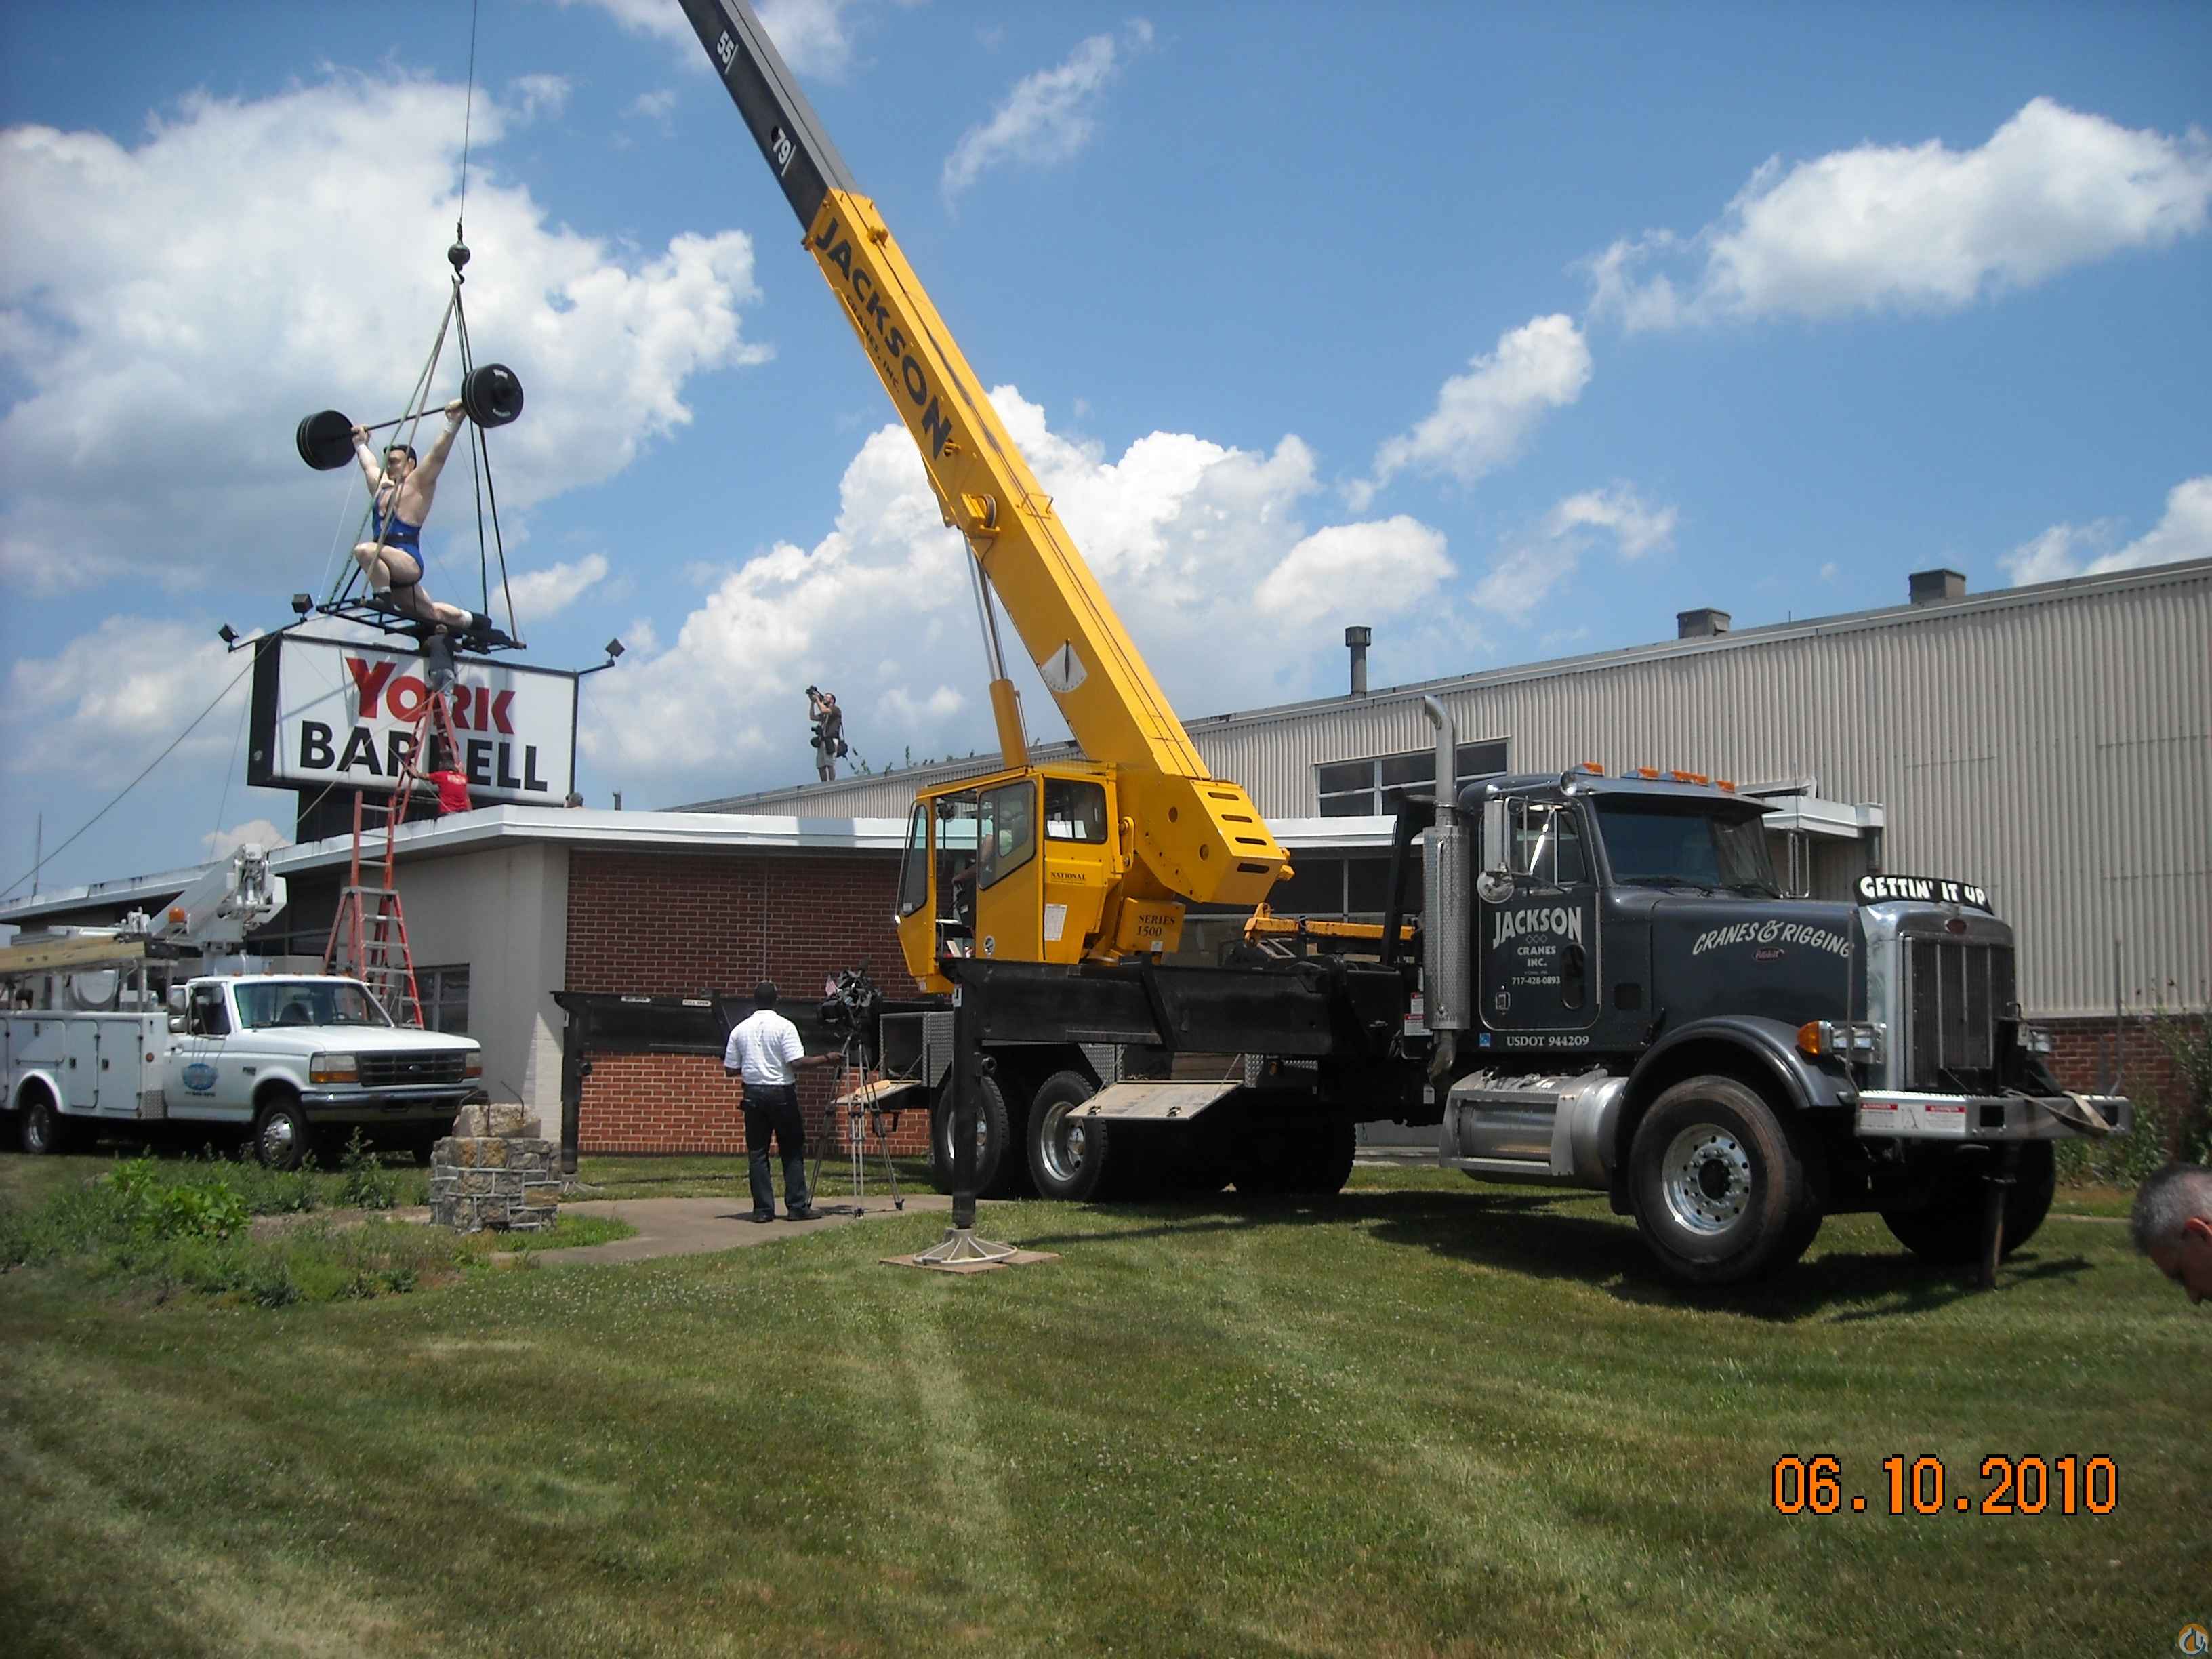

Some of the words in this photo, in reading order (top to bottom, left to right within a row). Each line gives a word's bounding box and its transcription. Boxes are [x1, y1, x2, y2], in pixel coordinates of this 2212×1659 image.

[717, 30, 734, 64] 55
[773, 127, 791, 165] 79
[815, 217, 953, 462] JACKSON
[345, 657, 516, 735] YORK
[1051, 872, 1085, 880] NATIONAL
[1860, 876, 1933, 899] GETTIN'
[1941, 882, 1959, 902] IT
[1964, 885, 1986, 906] UP
[1137, 926, 1162, 937] 1500
[1139, 915, 1175, 925] SERIES
[1493, 907, 1582, 949] JACKSON
[1517, 946, 1557, 956] CRANES
[1692, 922, 1759, 956] CRANES
[1757, 920, 1784, 943] &
[1781, 924, 1855, 958] RIGGING
[1528, 958, 1547, 967] INC.
[1507, 1036, 1544, 1046] USDOT
[1549, 1035, 1589, 1046] 944209
